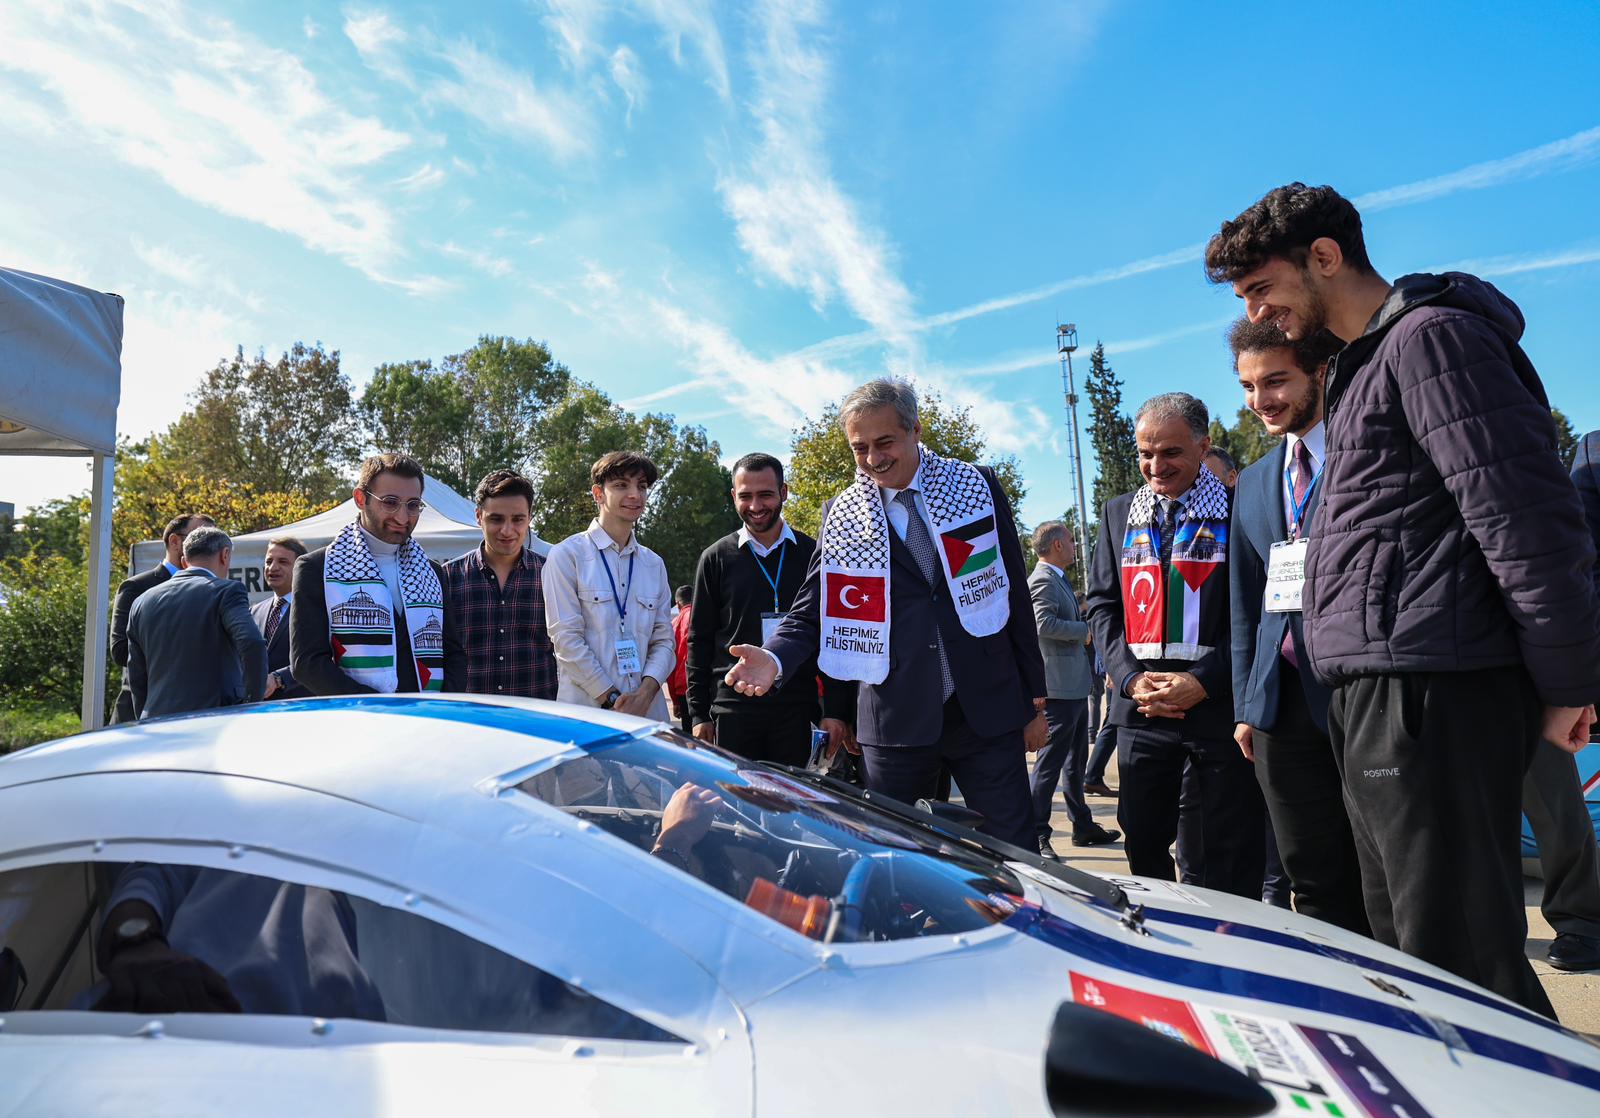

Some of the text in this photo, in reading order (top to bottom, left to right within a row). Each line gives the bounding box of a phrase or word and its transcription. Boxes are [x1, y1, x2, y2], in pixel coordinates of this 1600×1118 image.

[833, 626, 879, 639] HEPİMİZ
[825, 636, 884, 654] FİLİSTİNLİYİZ
[1363, 767, 1400, 778] POSITIVE
